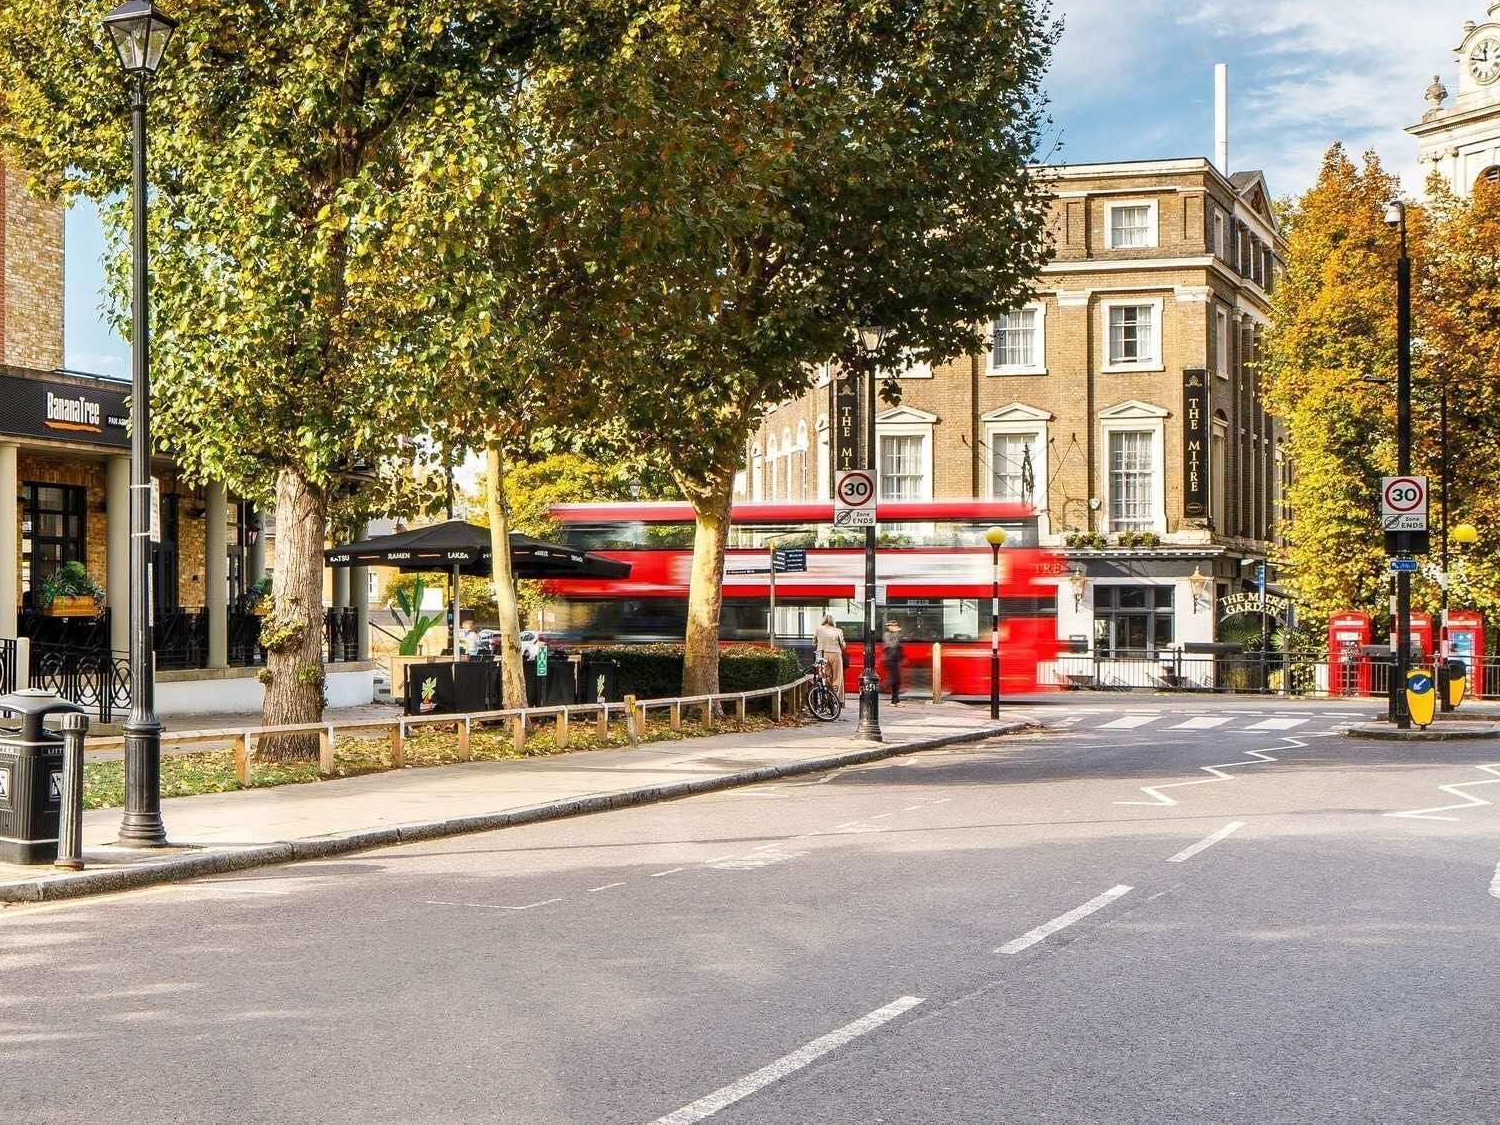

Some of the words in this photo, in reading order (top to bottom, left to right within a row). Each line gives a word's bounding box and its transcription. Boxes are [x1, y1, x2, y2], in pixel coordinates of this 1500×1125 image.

[47, 392, 100, 425] BananaTree
[1188, 398, 1200, 430] THE
[842, 406, 852, 437] THE
[1188, 440, 1200, 492] MITRE
[844, 482, 868, 496] 30
[1392, 488, 1417, 502] 30
[387, 552, 411, 560] RAMEN
[1219, 592, 1245, 606] THE
[1247, 591, 1286, 610] MTRE
